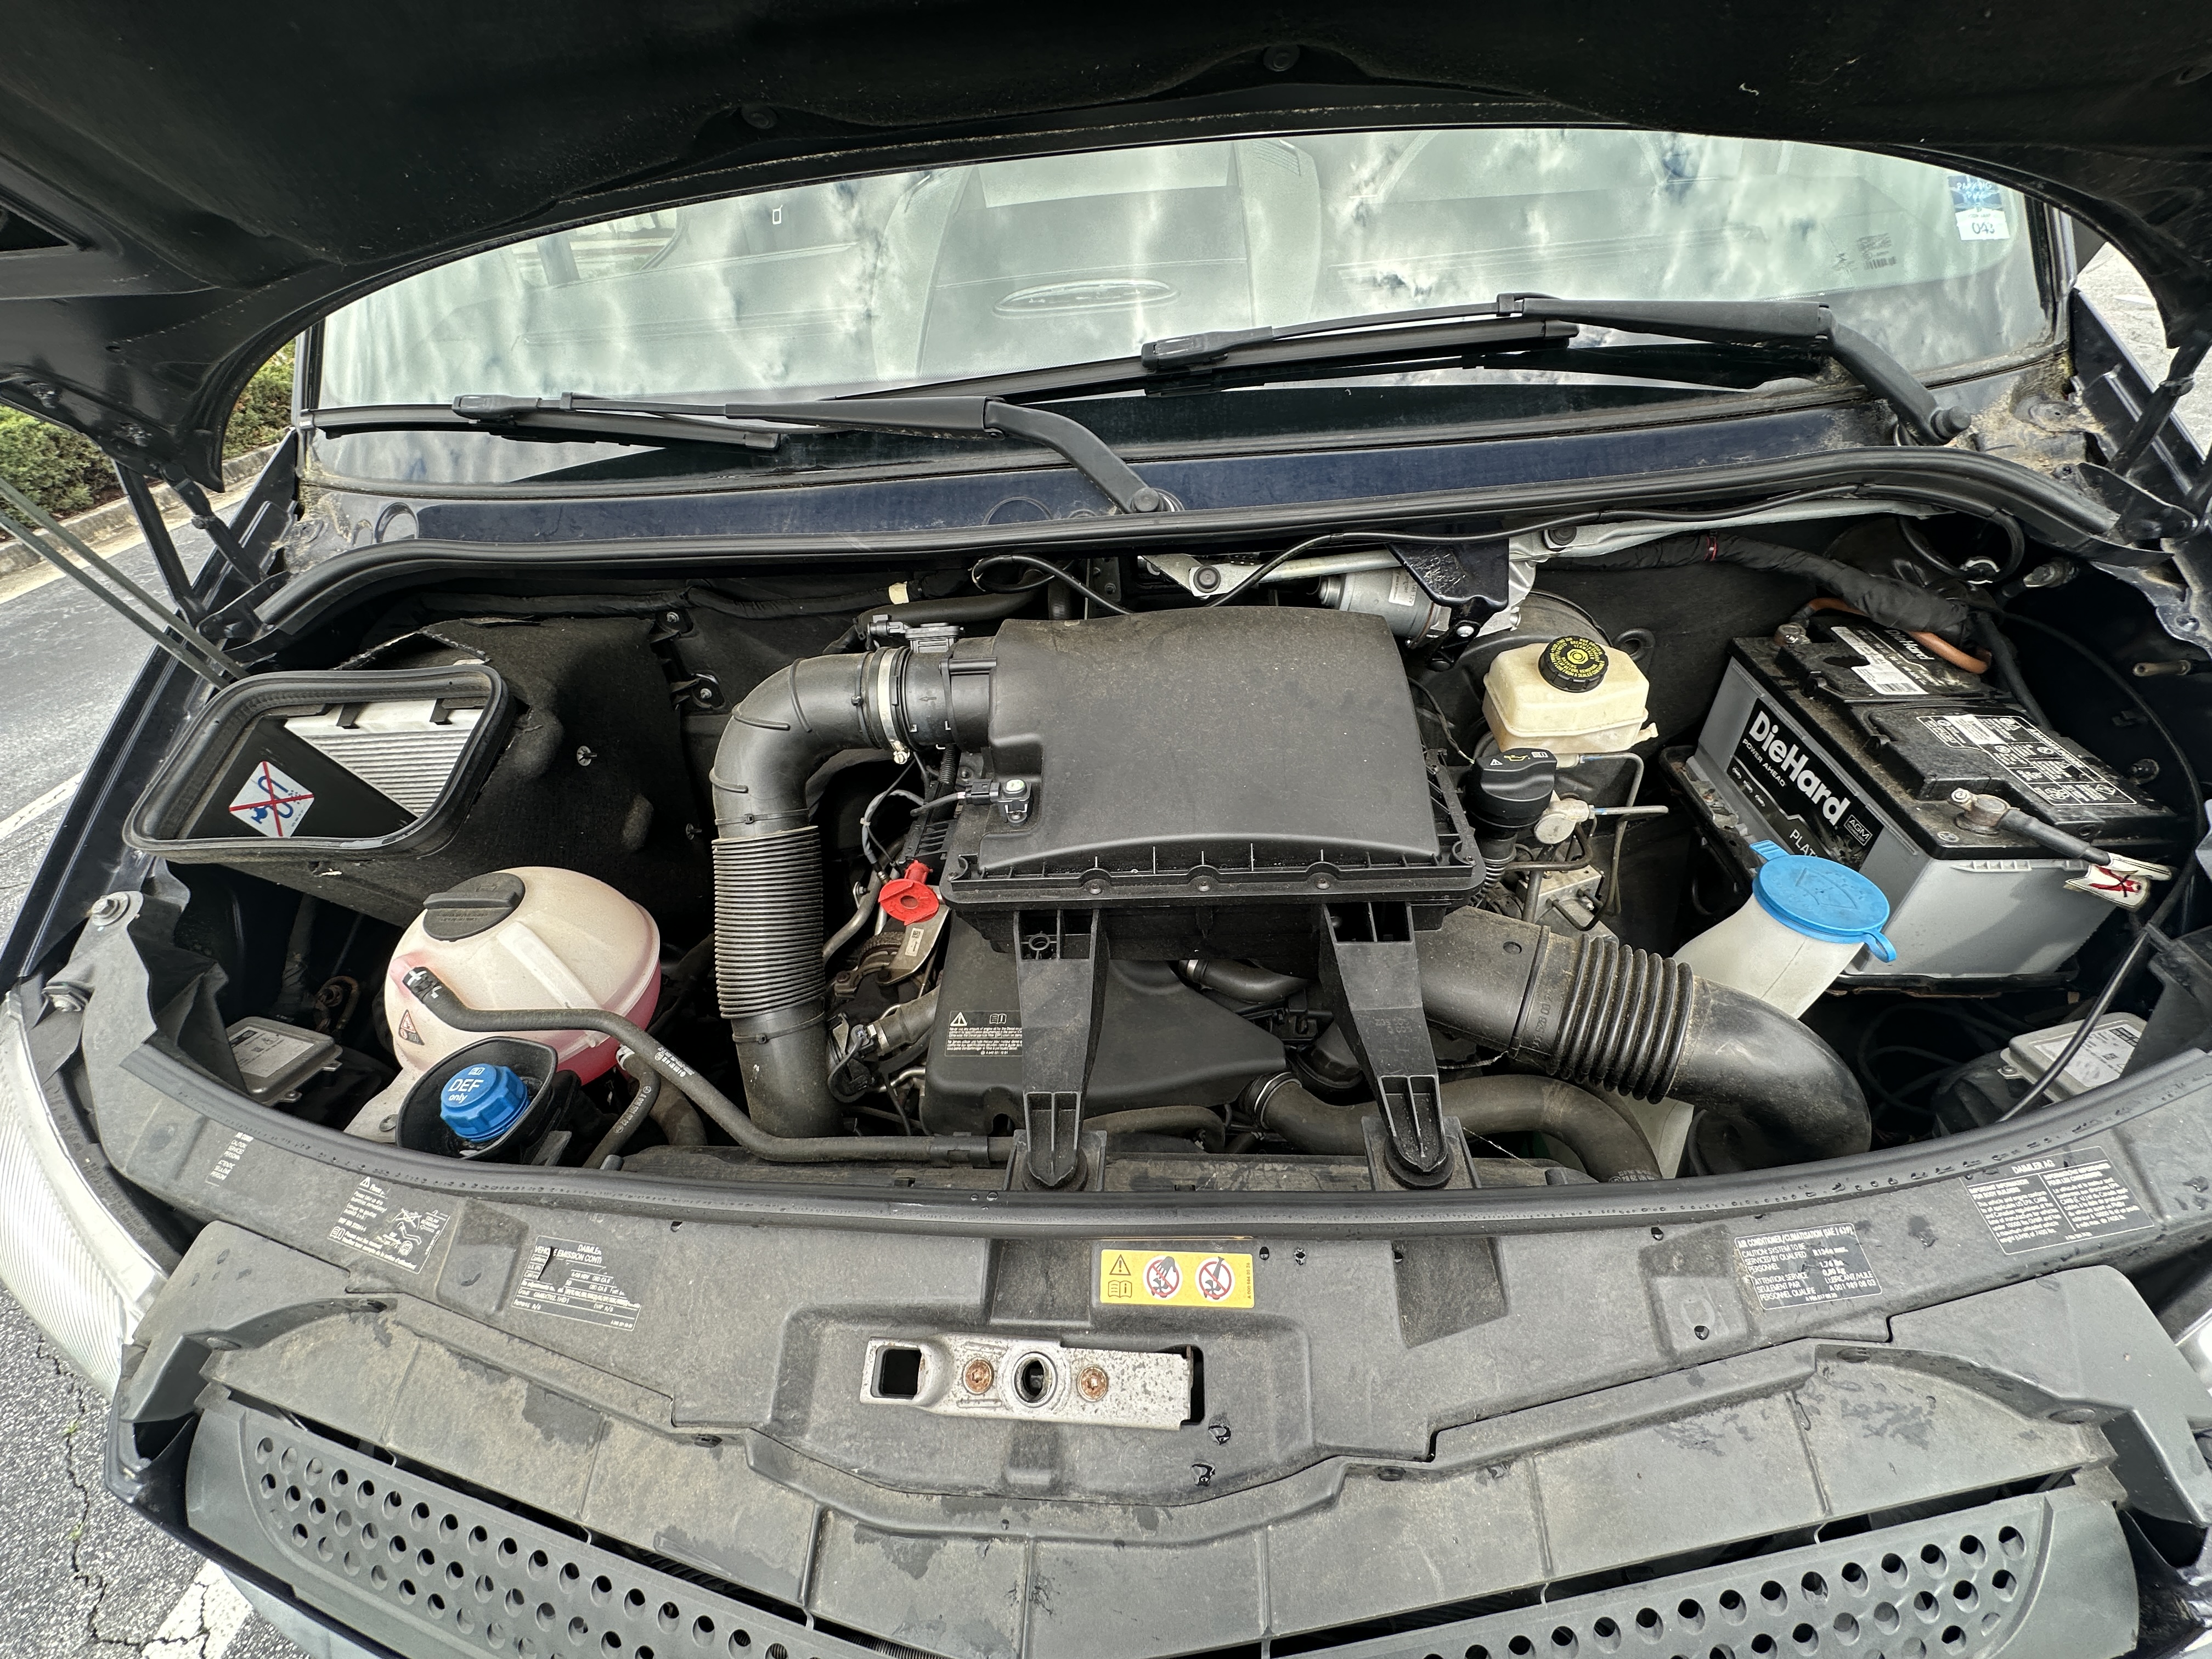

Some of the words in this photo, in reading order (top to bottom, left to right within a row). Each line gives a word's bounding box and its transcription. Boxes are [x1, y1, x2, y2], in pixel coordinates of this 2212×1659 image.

[1742, 738, 1763, 763] POWER
[1762, 763, 1785, 787] AHEAD
[1749, 711, 1851, 826] DieHard
[1849, 819, 1870, 839] AGM
[1789, 829, 1819, 857] PLAT
[448, 1079, 484, 1092] DEF
[448, 1093, 468, 1103] only
[2011, 1161, 2044, 1174] DAIMLER
[2042, 1159, 2056, 1169] AG
[1737, 1239, 1748, 1249] AIR
[1767, 1244, 1791, 1255] SYSTEM
[1797, 1242, 1807, 1250] BE
[556, 1249, 585, 1261] EMISSION
[1744, 1255, 1771, 1266] SERVICED
[1770, 1254, 1779, 1262] BY
[1747, 1262, 1780, 1273] PERSONNEL
[1784, 1271, 1809, 1281] SERVICE
[1756, 1282, 1788, 1293] SEULEMENT
[1787, 1280, 1801, 1289] PAR
[1759, 1290, 1792, 1301] PERSONNEL
